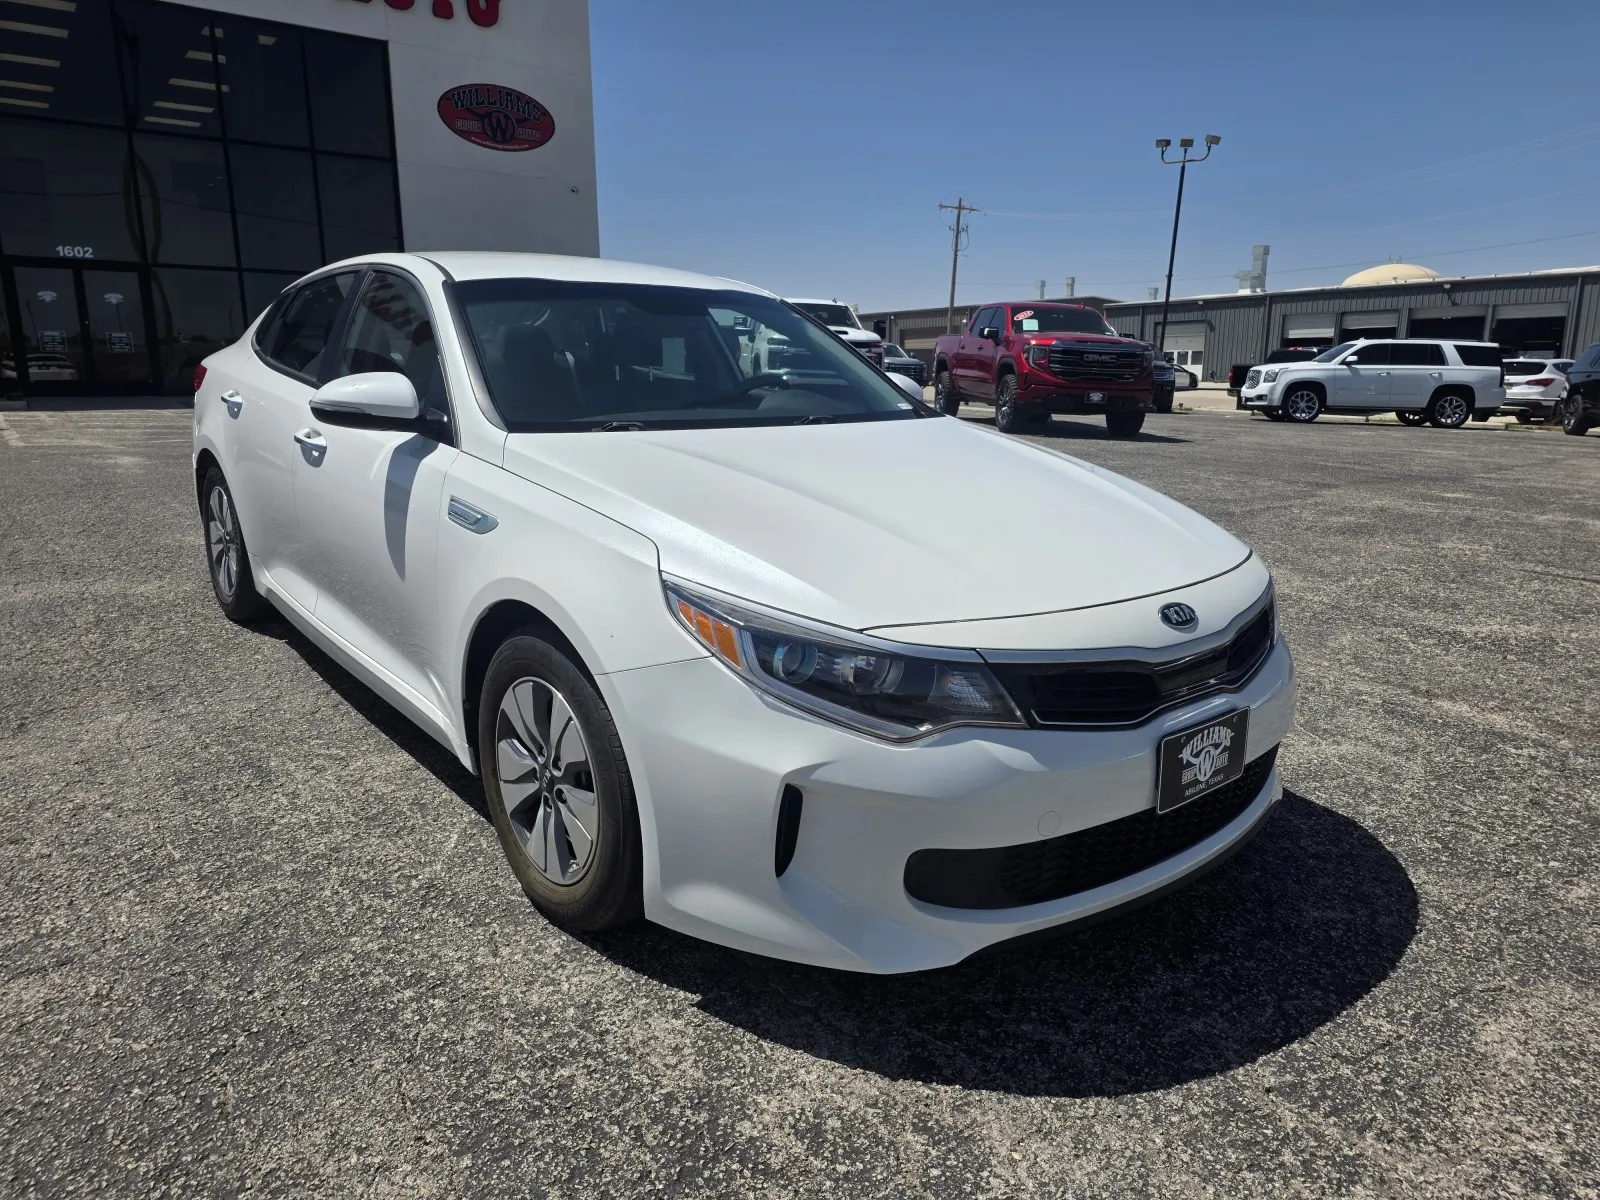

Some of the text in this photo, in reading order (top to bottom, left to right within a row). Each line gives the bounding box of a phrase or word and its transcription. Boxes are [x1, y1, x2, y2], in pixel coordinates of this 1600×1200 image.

[450, 87, 542, 123] WILLIAMS
[455, 109, 541, 142] GROUP W AUTO
[56, 245, 94, 258] 1602
[1083, 353, 1117, 363] GMC
[1182, 726, 1232, 764] WILLIAMS
[1208, 773, 1224, 786] TEXAS
